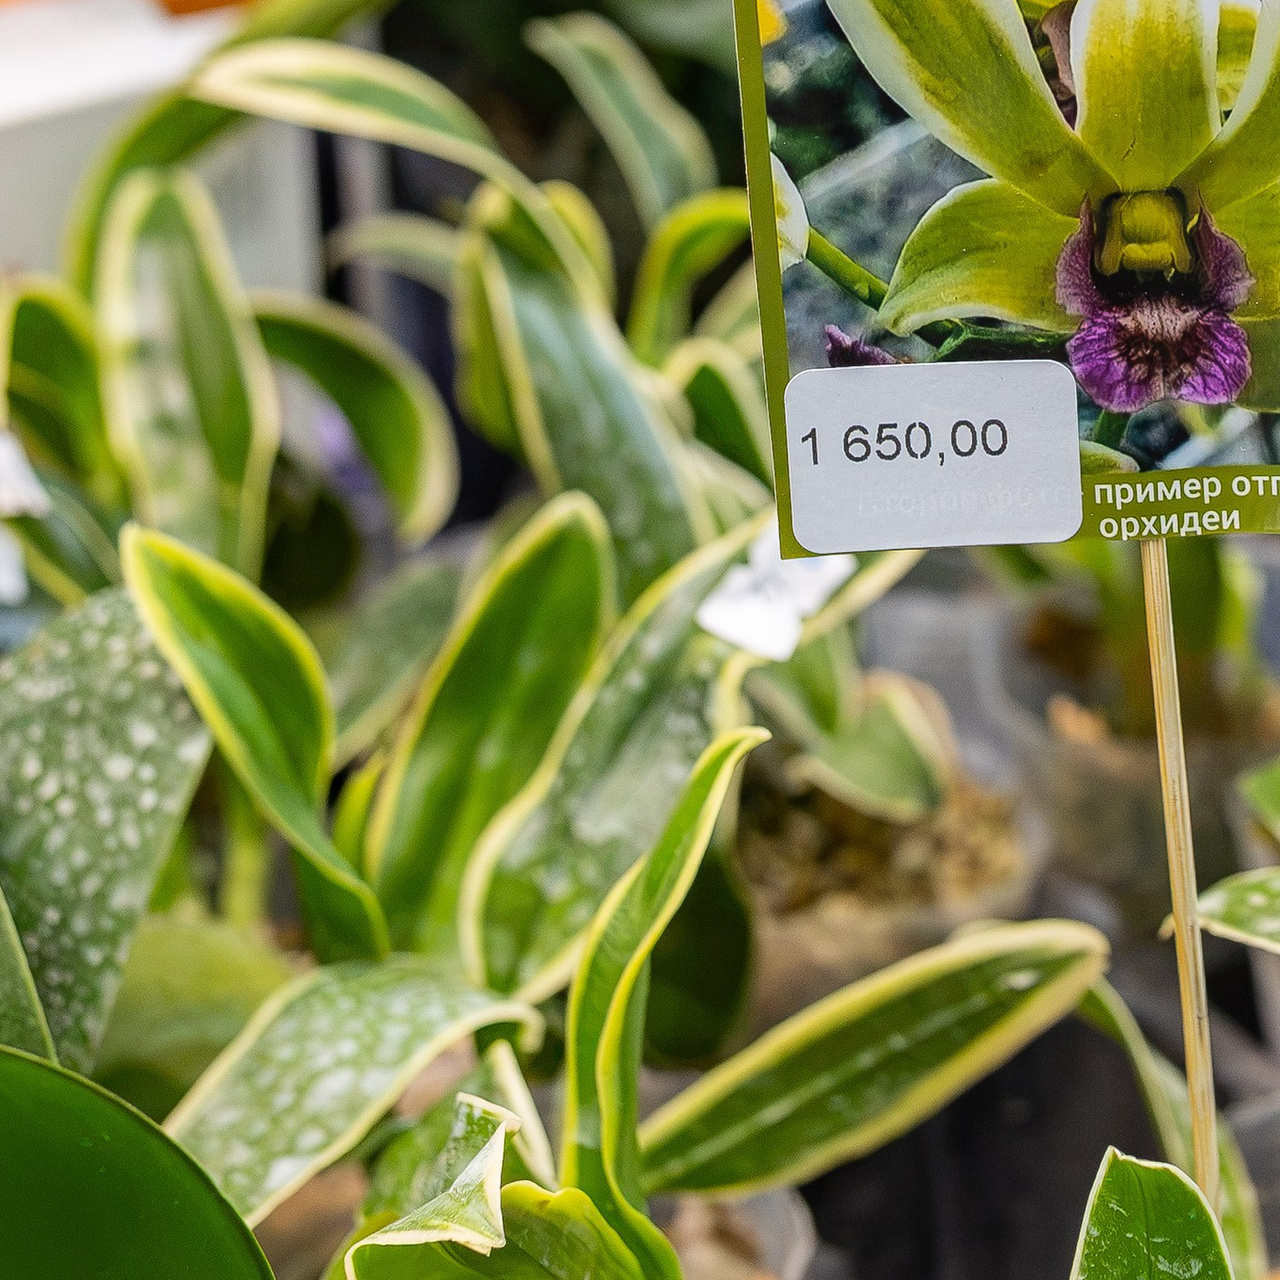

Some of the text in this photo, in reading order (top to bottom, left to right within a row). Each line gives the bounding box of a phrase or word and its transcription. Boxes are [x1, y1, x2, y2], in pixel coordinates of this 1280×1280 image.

[799, 417, 1010, 468] 1 650,00
[1094, 477, 1222, 510] пример
[1099, 509, 1240, 543] орхидеи
